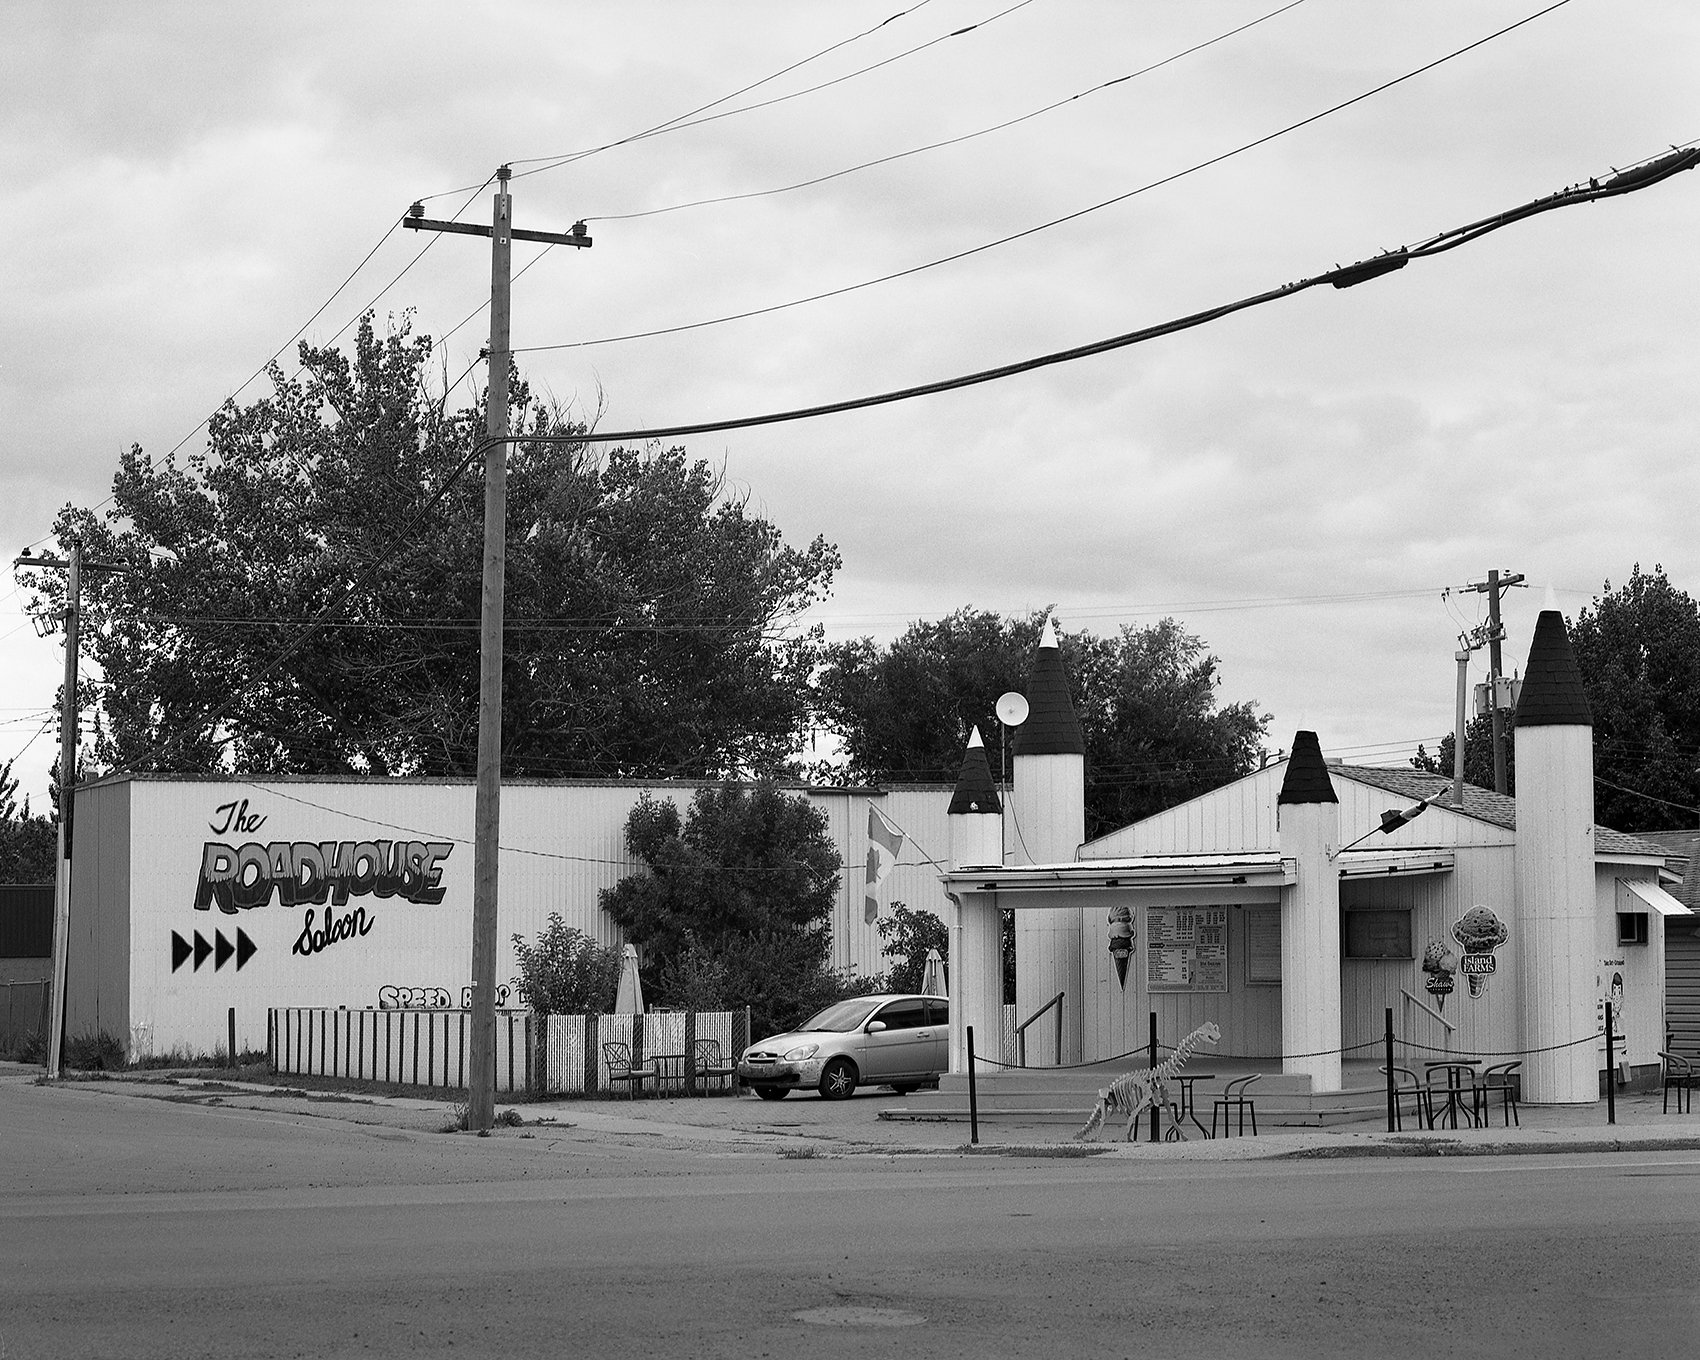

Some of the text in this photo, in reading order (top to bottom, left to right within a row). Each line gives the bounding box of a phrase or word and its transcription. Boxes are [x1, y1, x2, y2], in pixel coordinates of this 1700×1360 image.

[208, 799, 268, 835] The
[193, 839, 454, 914] ROADHOUSE
[292, 906, 375, 956] Saloon
[1463, 964, 1494, 972] FARMS
[379, 984, 451, 1009] SPEED
